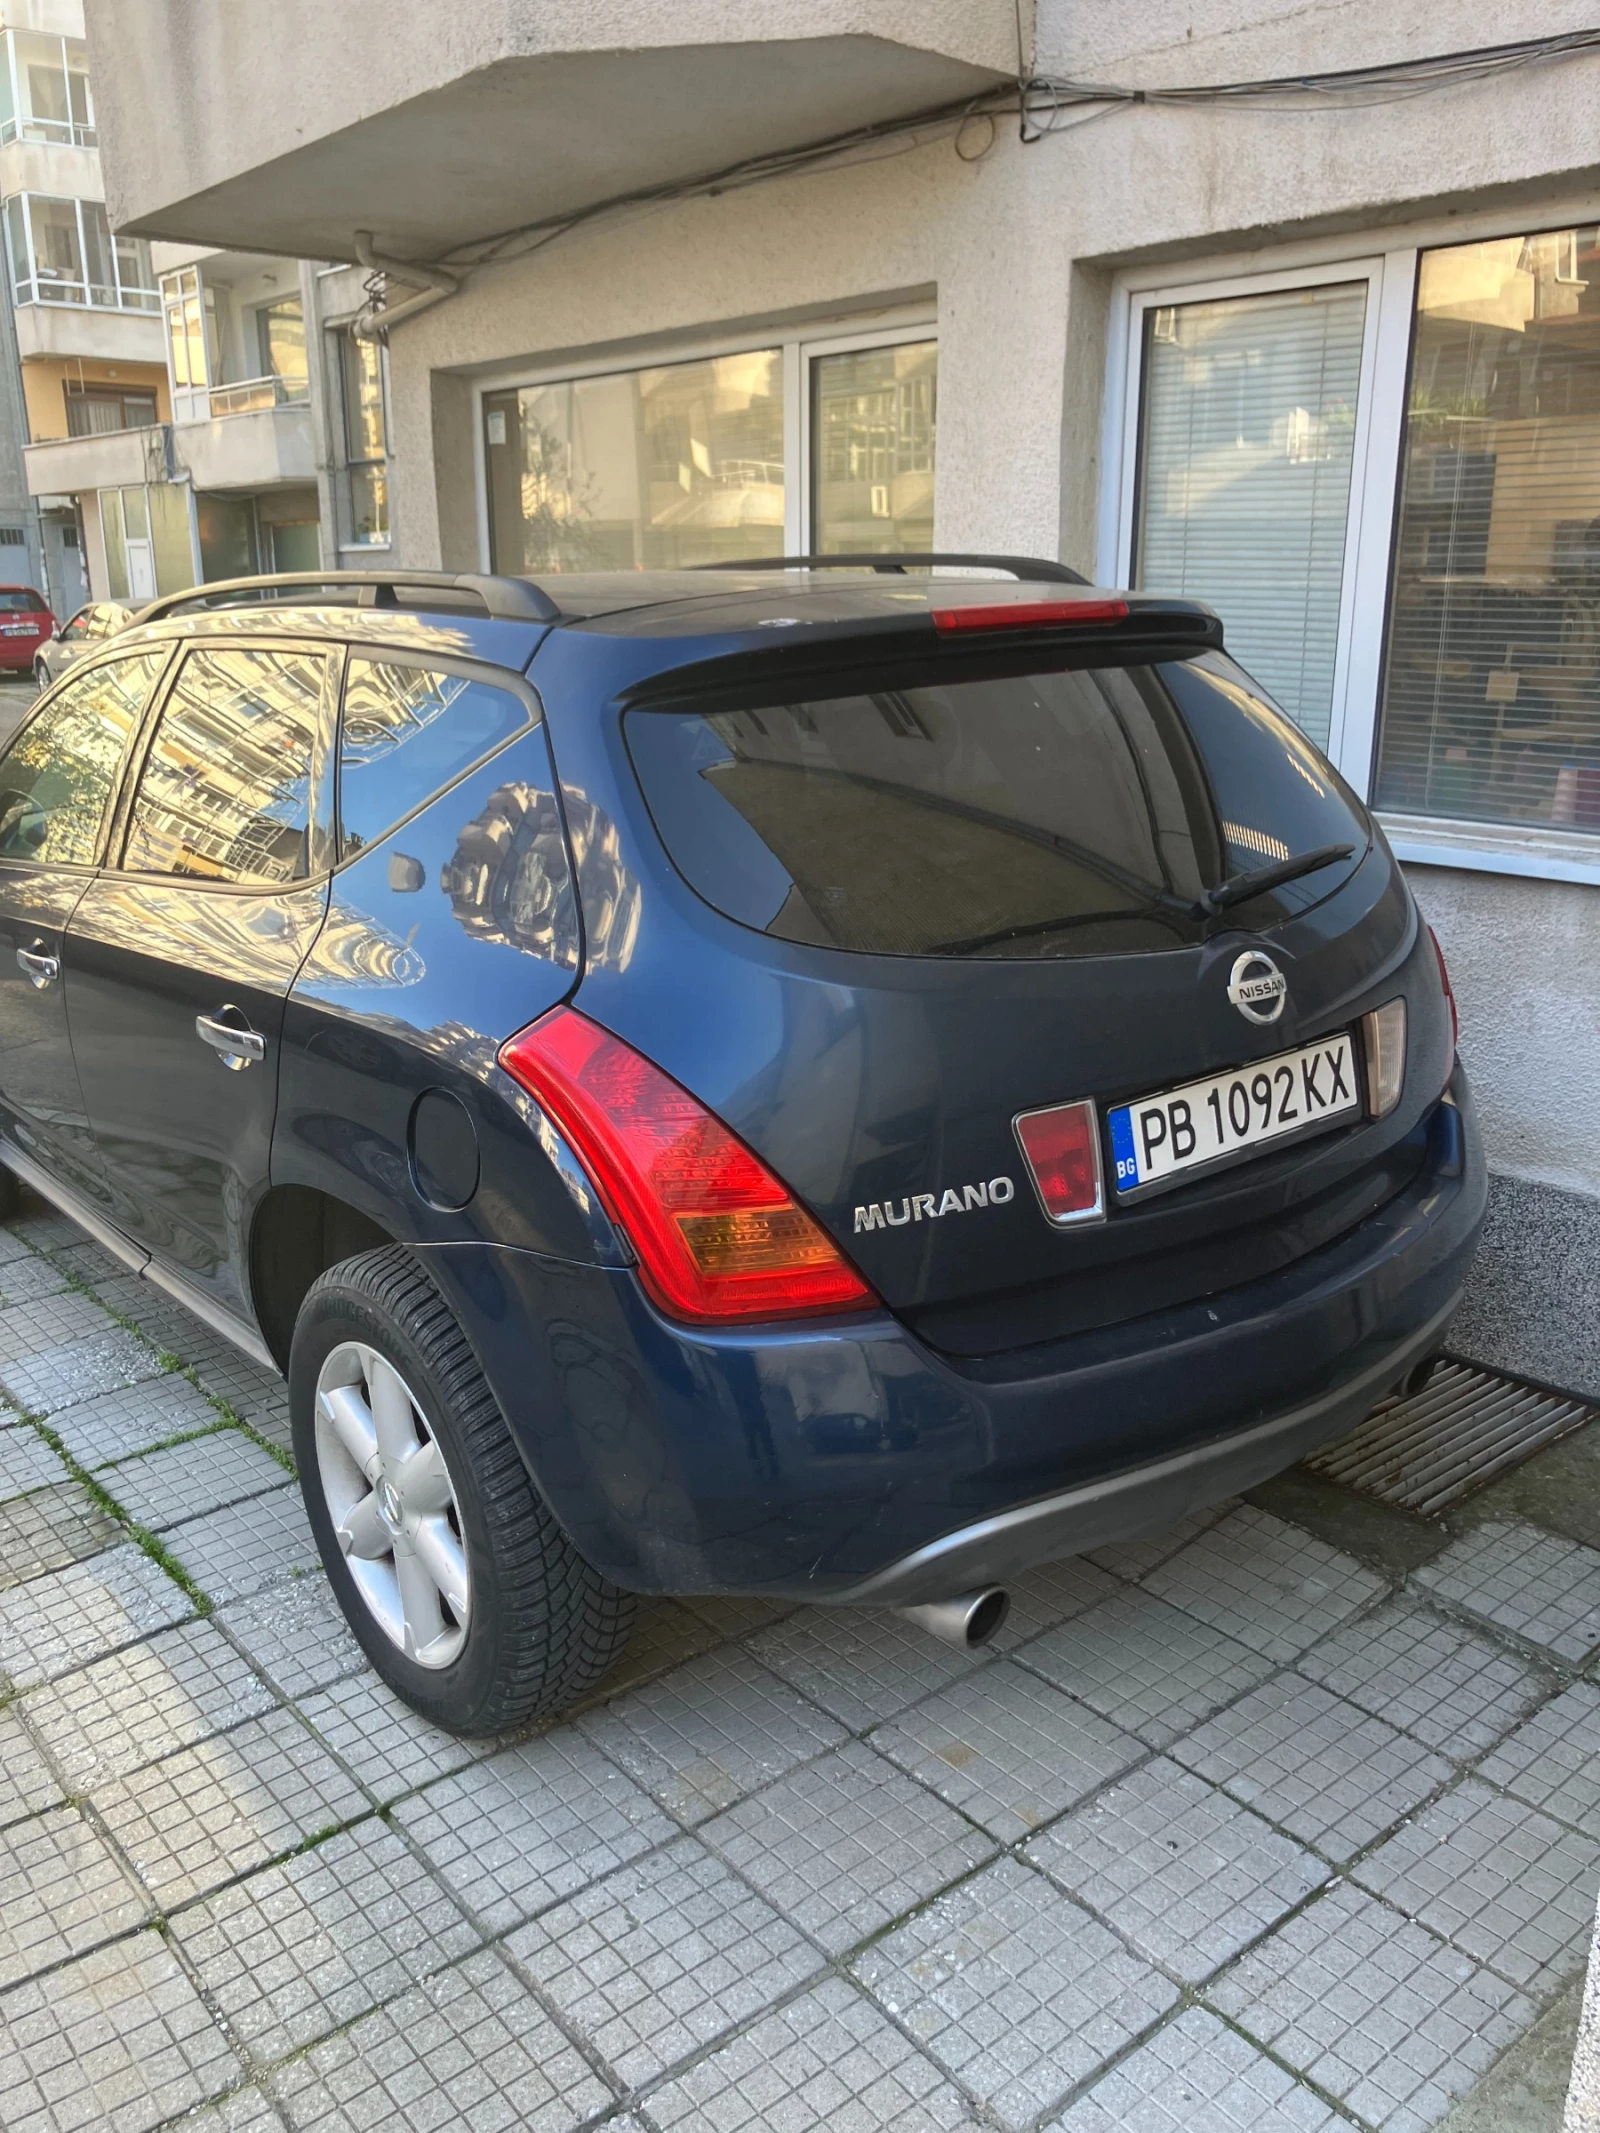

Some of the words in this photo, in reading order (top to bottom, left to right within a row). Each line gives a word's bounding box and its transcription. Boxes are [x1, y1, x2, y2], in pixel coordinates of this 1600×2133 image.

[1239, 978, 1285, 1000] NISSAN
[1140, 1099, 1196, 1170] PB
[1116, 1157, 1136, 1179] BG
[853, 1176, 1015, 1234] MURANO
